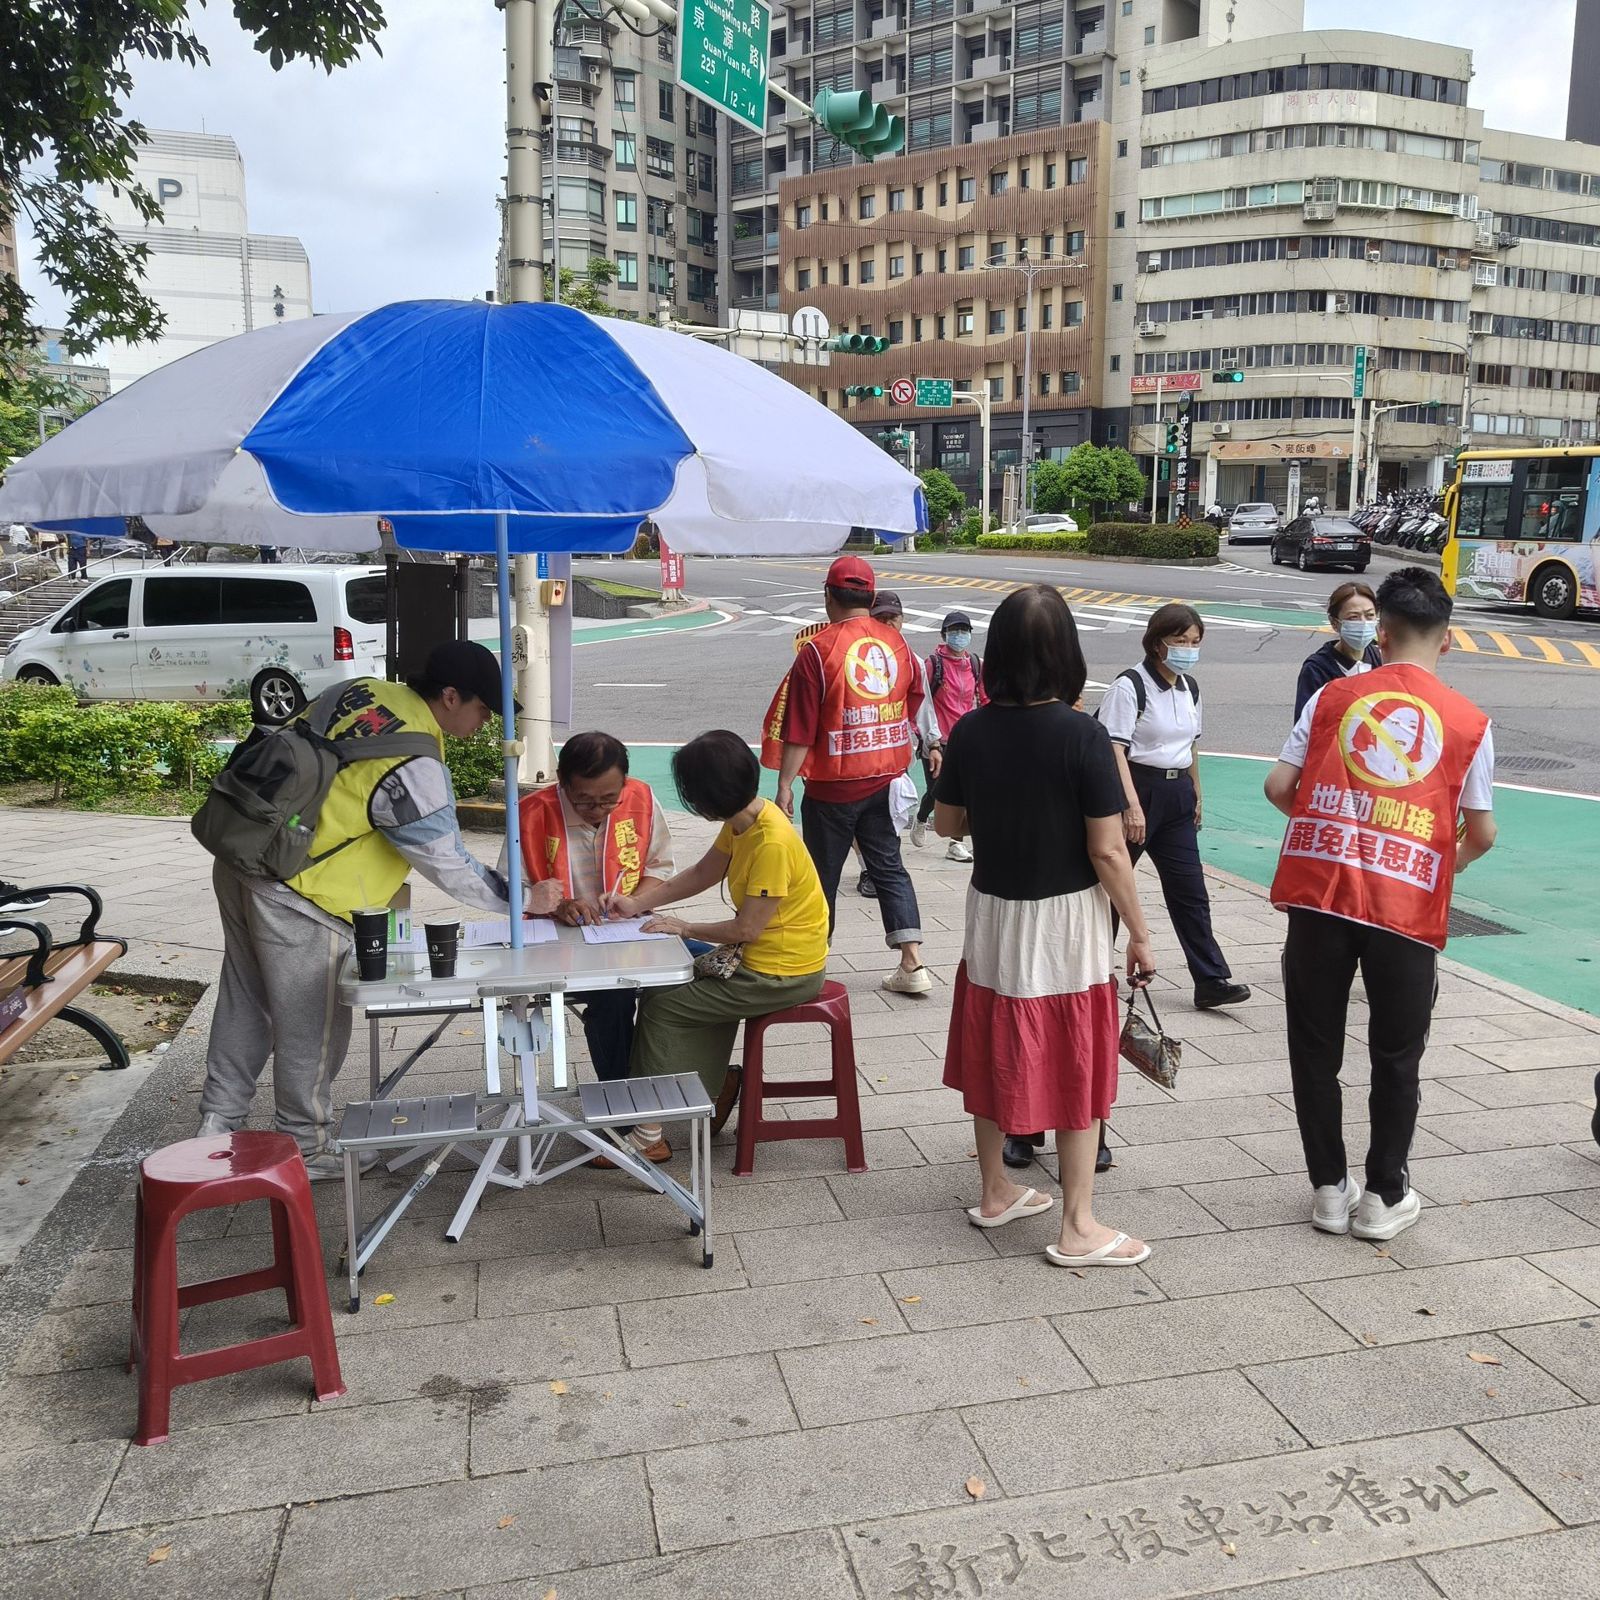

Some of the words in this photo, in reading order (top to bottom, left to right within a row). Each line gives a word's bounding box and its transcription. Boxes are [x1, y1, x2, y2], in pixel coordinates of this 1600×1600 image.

[693, 6, 759, 69] 泉源路
[701, 54, 716, 75] 225
[158, 178, 182, 205] P
[1308, 783, 1436, 842] 地動刪瑤
[1287, 821, 1436, 886] 罷免吳思瑤
